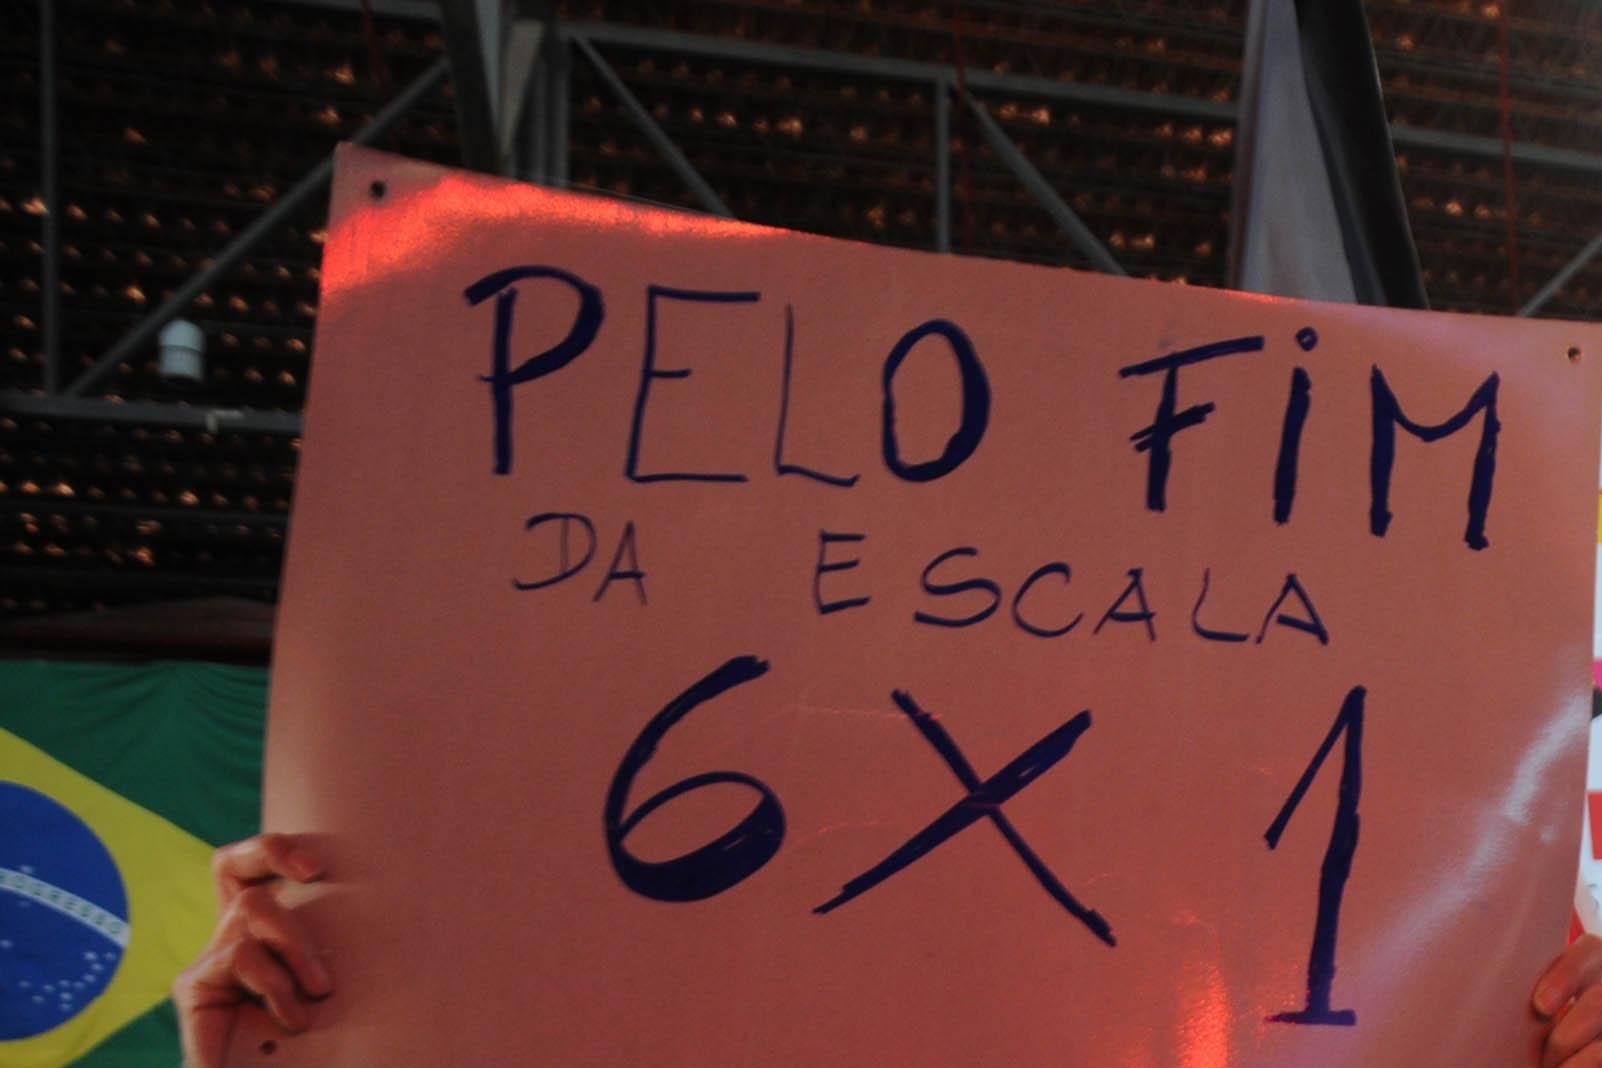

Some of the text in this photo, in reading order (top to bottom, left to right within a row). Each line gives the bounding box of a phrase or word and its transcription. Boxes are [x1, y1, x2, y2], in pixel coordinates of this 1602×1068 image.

[464, 263, 992, 486] PELO
[509, 512, 1330, 648] DA ESCALA
